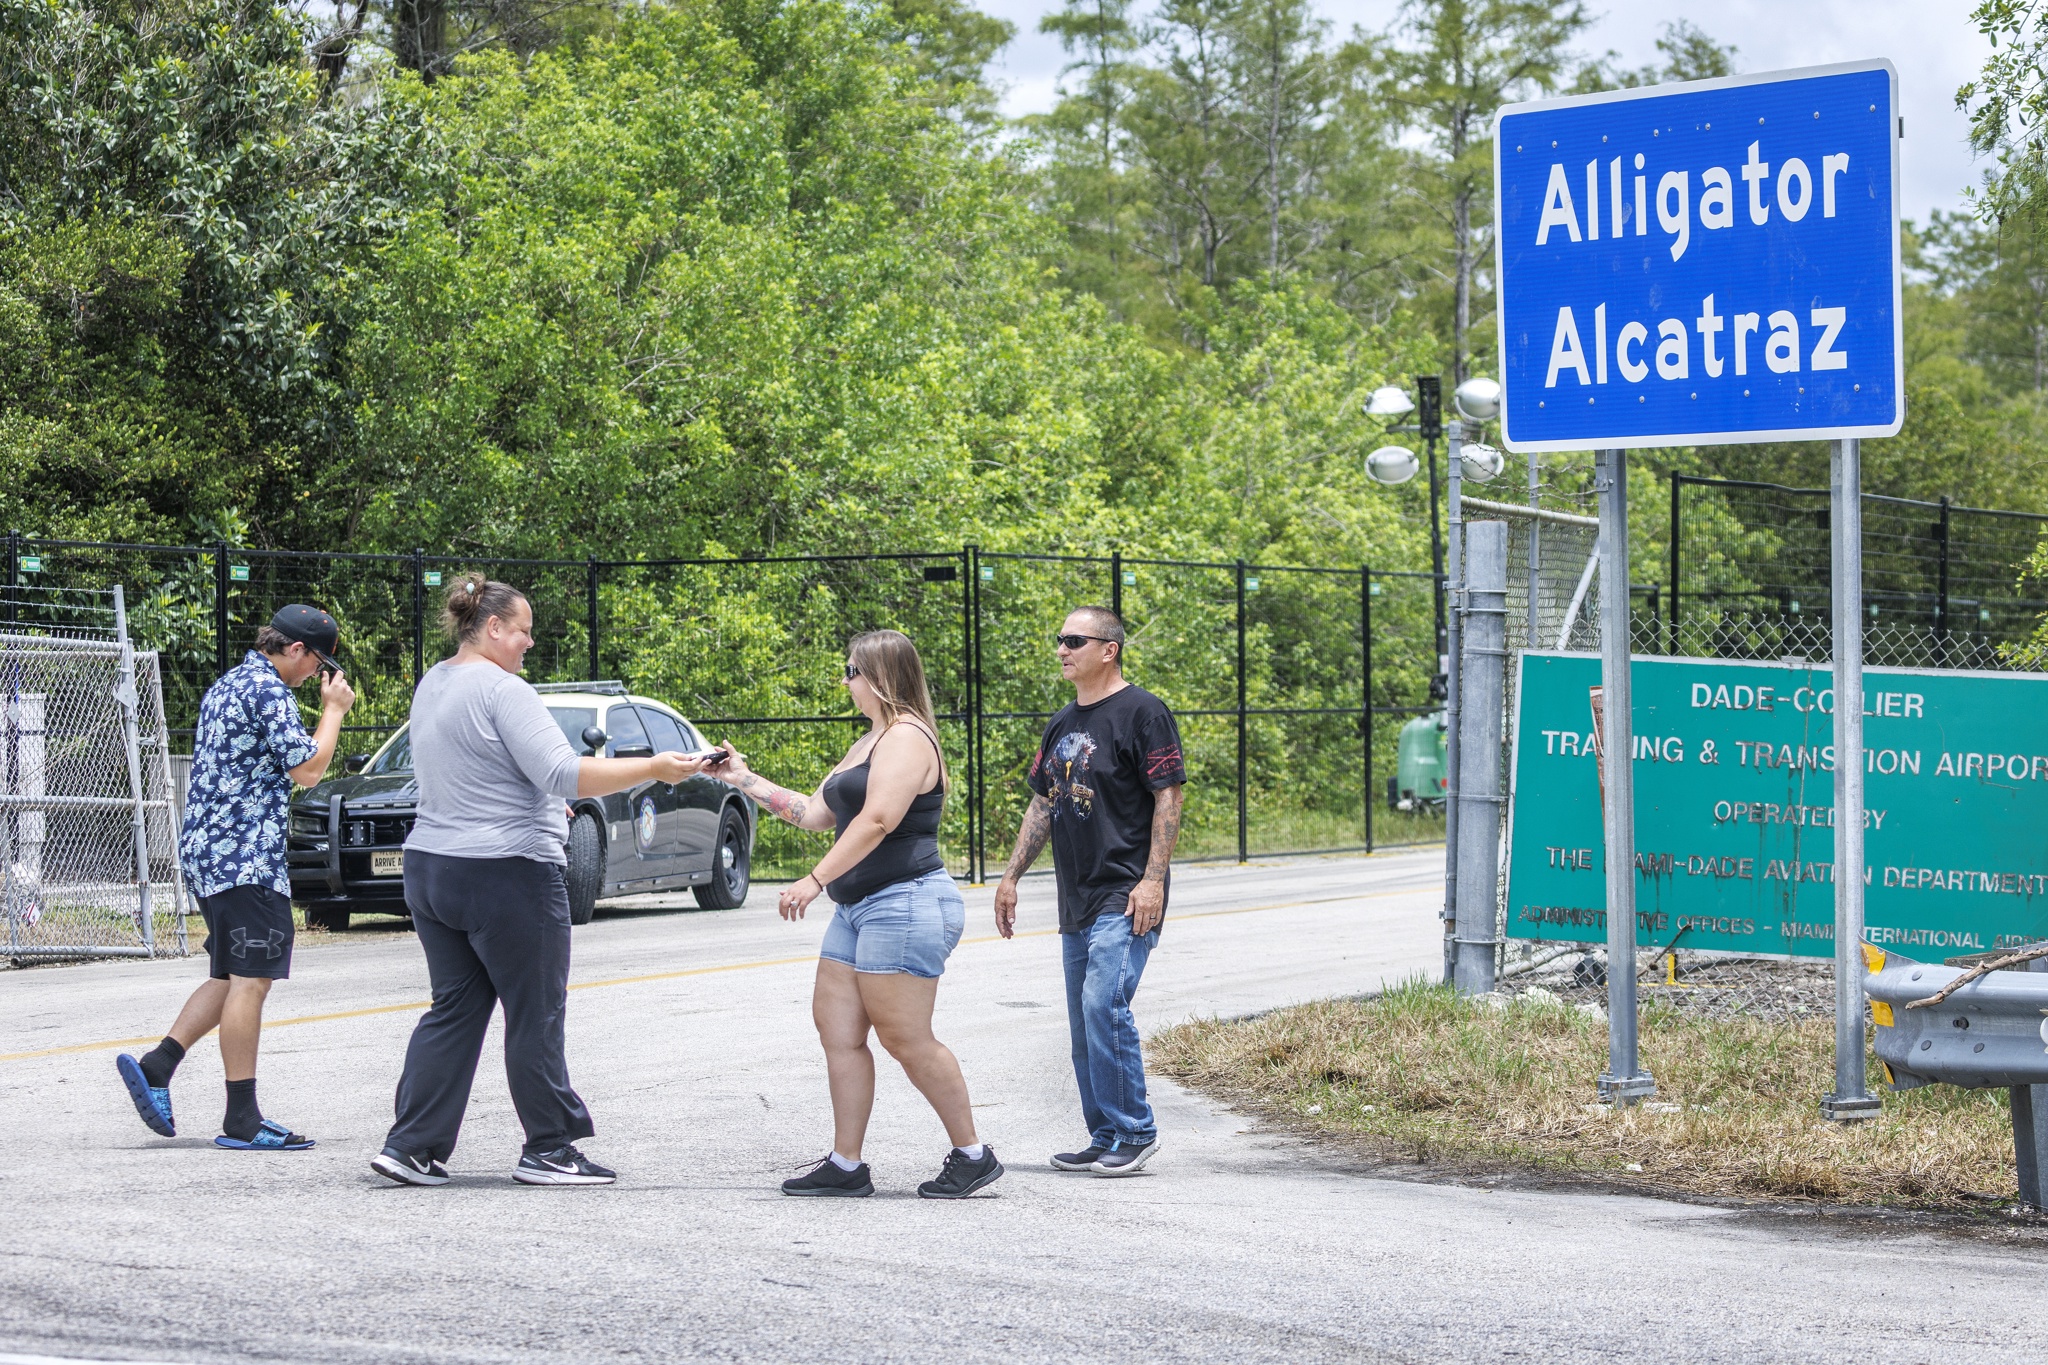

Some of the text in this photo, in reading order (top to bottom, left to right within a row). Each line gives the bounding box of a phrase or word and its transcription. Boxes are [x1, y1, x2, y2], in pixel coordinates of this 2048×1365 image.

[1536, 139, 1849, 262] Alligator
[1545, 292, 1848, 388] Alcatraz
[1691, 682, 1925, 719] DADE-COLIER
[1541, 729, 1684, 764] TRAING
[1699, 738, 1720, 765] &
[1735, 740, 1921, 775] TRANSION
[375, 857, 395, 867] ARRIVE
[1546, 846, 2048, 895] THE AMI-DADE AVIATIN DEPARTMENT
[1518, 904, 1669, 931] ADMINISTIVE
[1676, 913, 1755, 935] OFFICES
[1864, 926, 1985, 949] TERNATIONAL
[1992, 933, 2047, 950] AIRP
